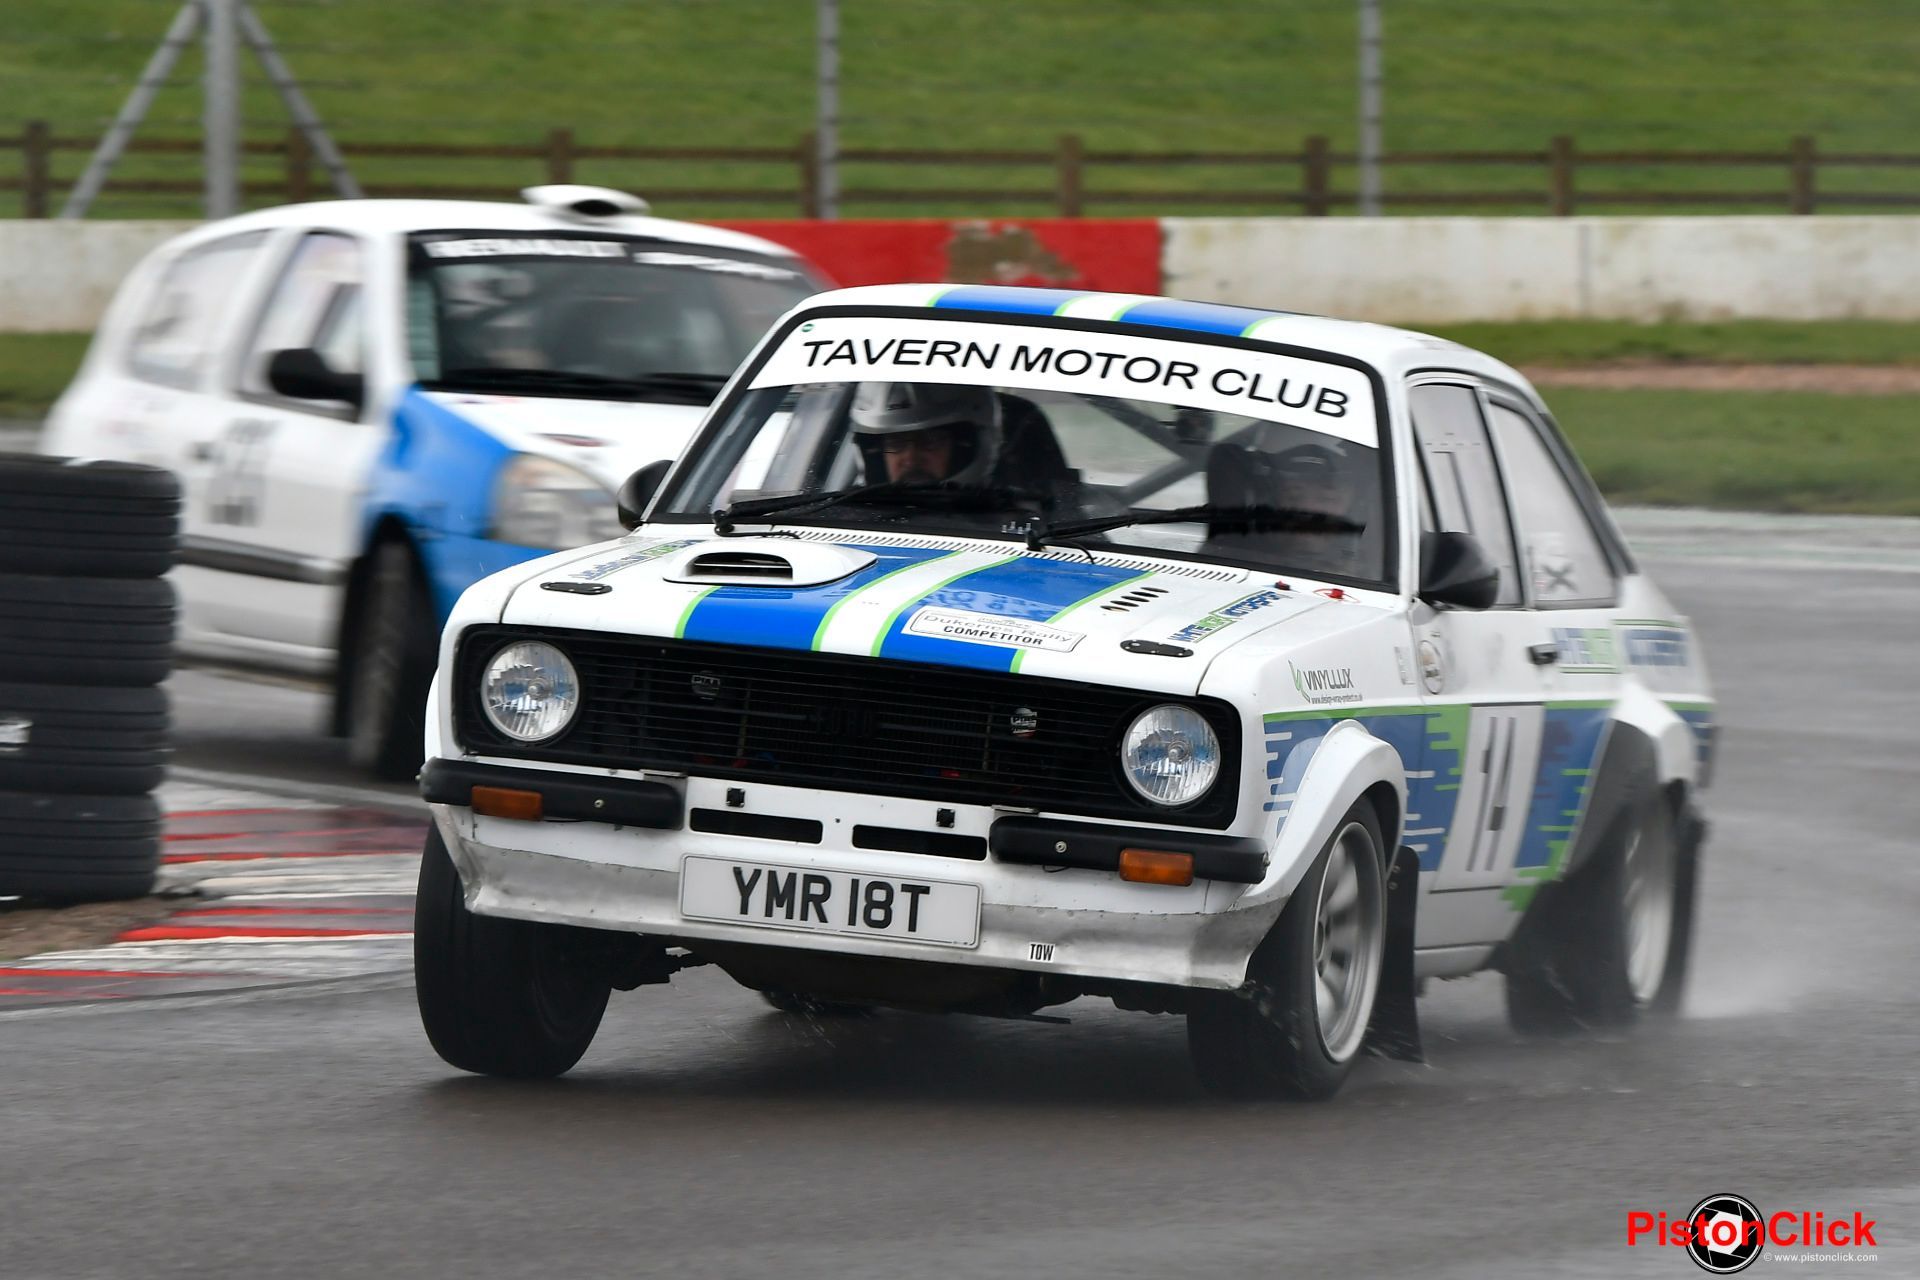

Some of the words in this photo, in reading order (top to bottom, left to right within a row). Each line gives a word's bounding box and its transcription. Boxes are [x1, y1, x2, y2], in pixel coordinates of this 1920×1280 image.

[803, 338, 1000, 369] TAVERN
[1011, 345, 1200, 390] MOTOR
[1211, 368, 1350, 418] CLUB
[943, 625, 1044, 646] COMPETITOR
[1021, 627, 1073, 643] Rally
[1303, 667, 1355, 691] VINYLLUX
[732, 866, 832, 924] YMR
[847, 878, 931, 933] 18T
[1029, 943, 1054, 962] TOW
